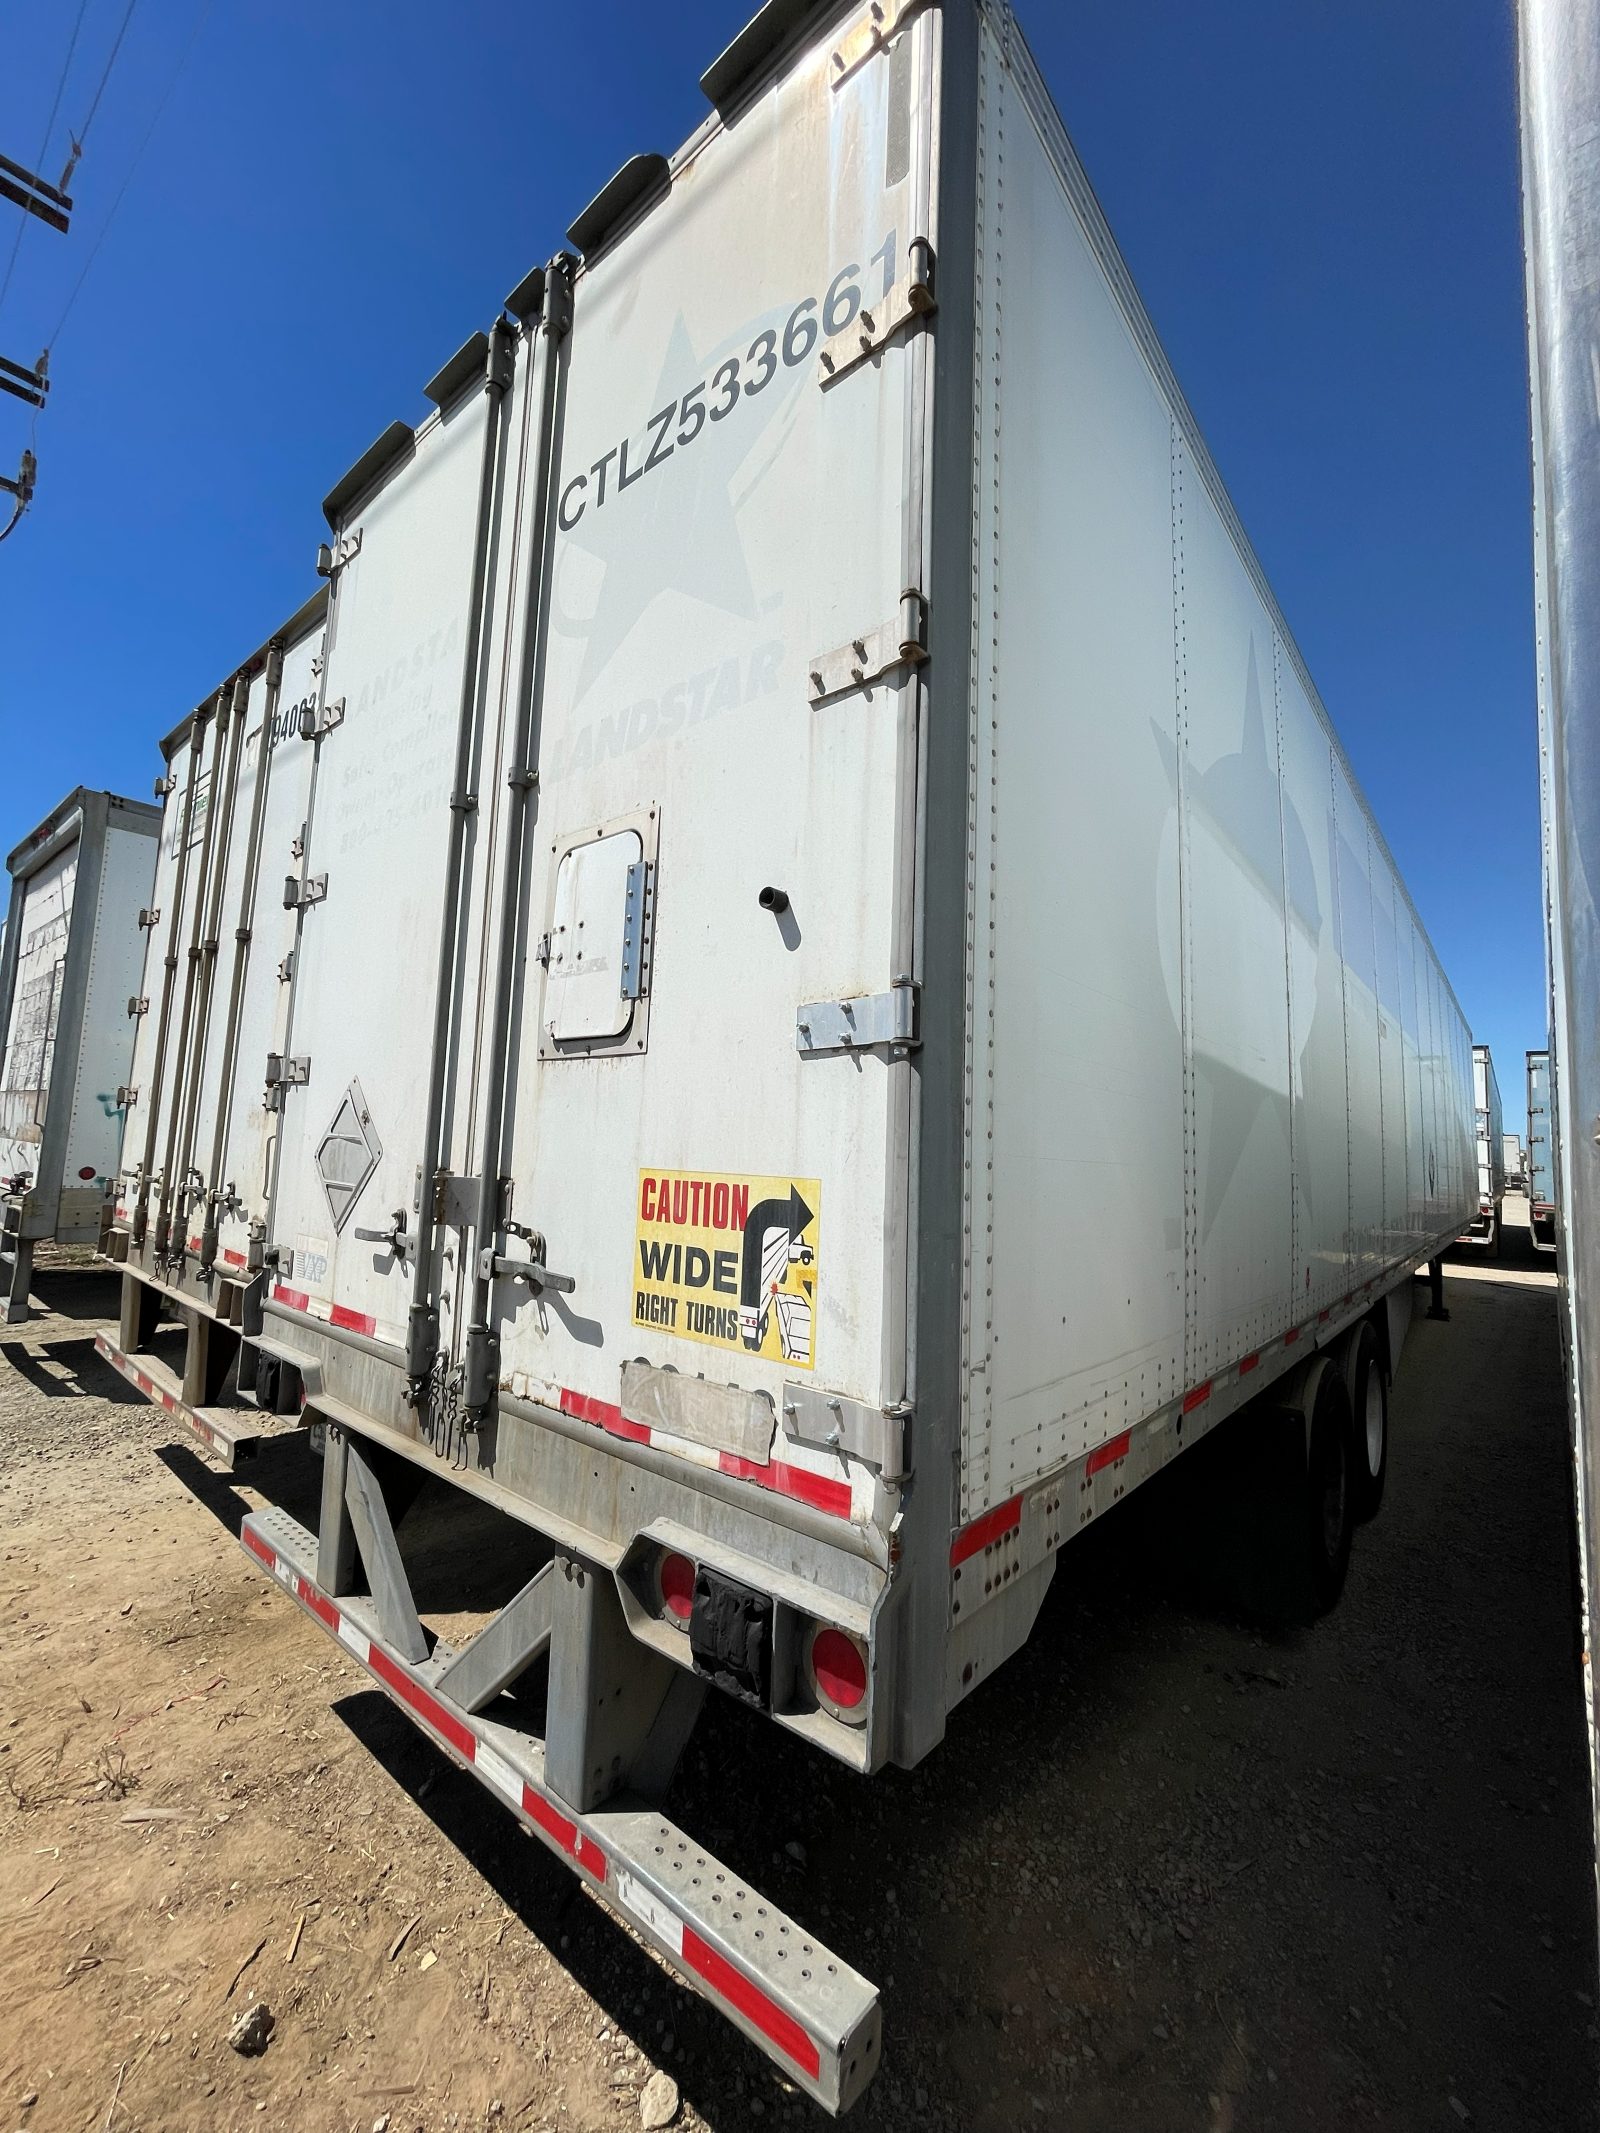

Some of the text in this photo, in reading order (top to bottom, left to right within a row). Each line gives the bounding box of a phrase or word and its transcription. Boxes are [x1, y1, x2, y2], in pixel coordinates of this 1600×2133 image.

[557, 228, 898, 532] CTLZ533661
[641, 1177, 750, 1231] CAUTION
[639, 1239, 739, 1295] WIDE
[635, 1291, 738, 1341] RIGHT TURNS
